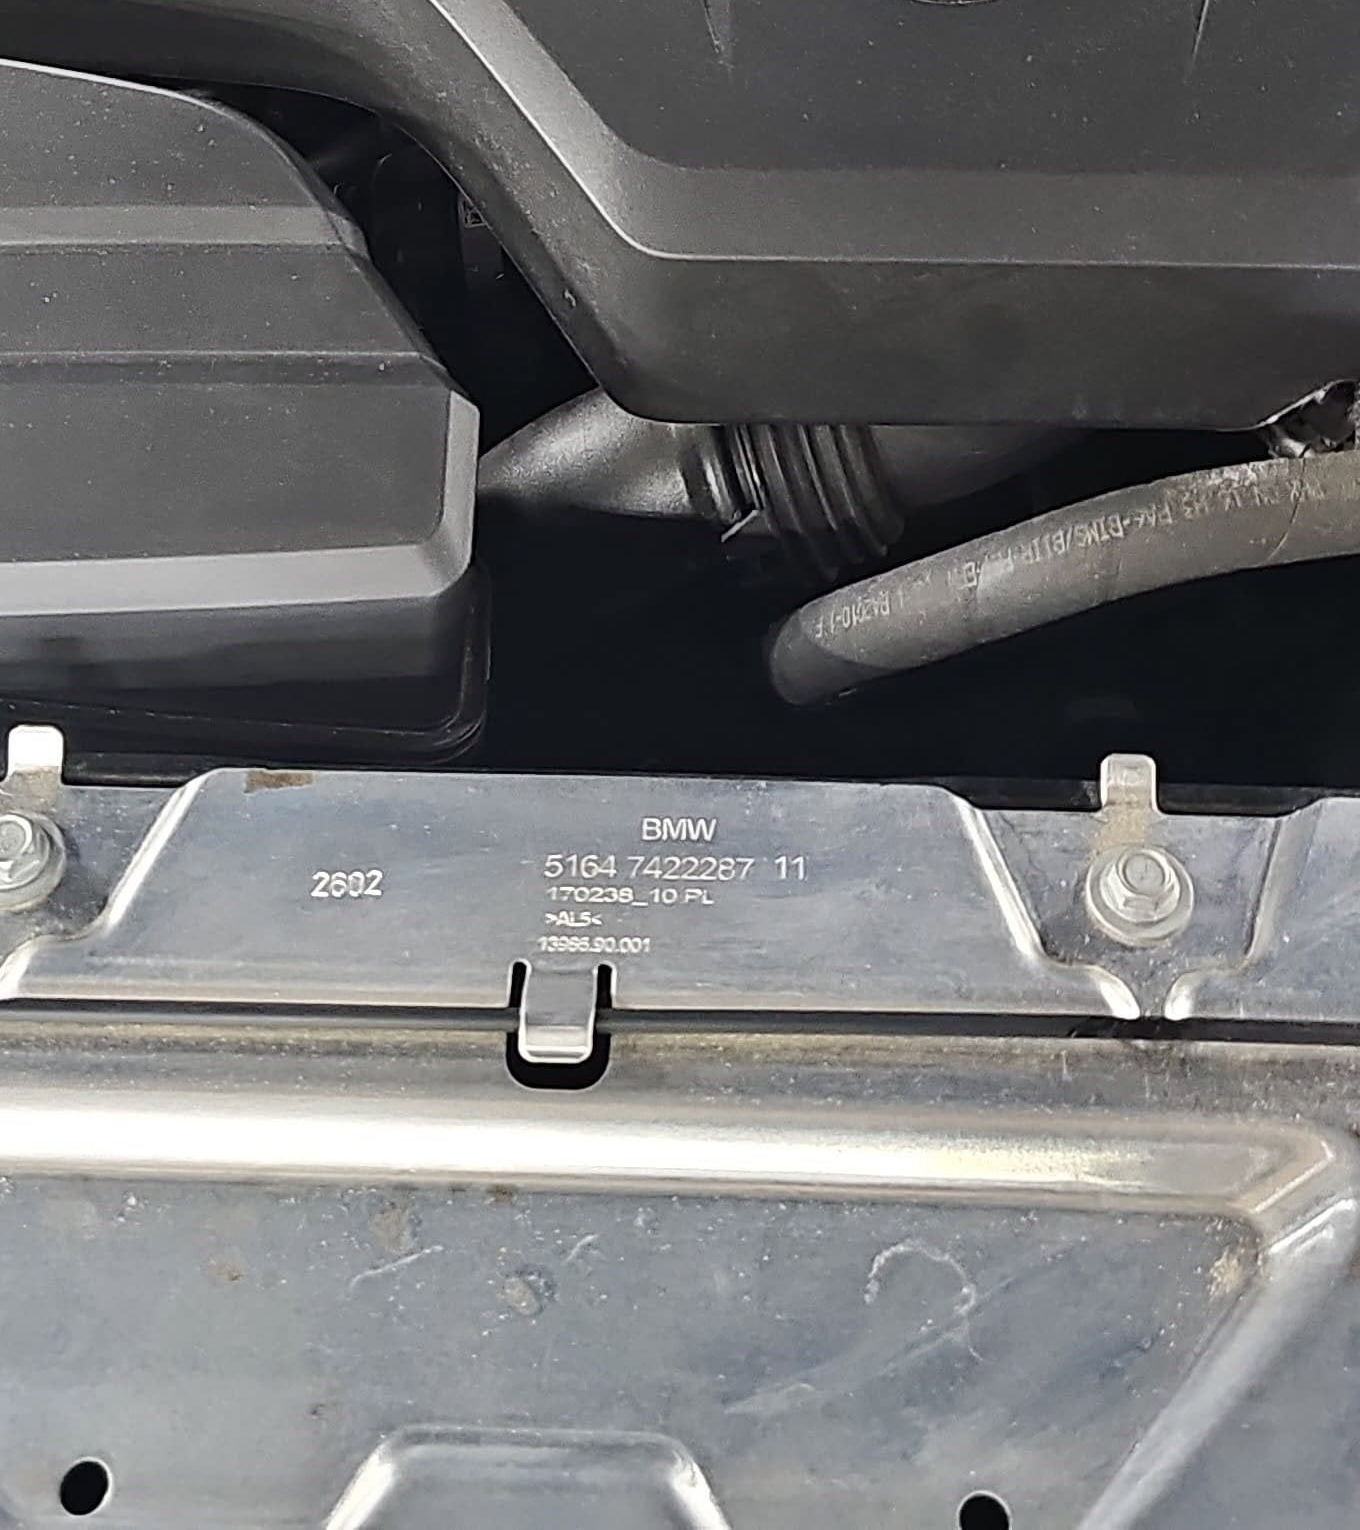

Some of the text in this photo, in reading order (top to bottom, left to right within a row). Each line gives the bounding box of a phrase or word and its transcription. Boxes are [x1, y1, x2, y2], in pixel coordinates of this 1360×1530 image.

[642, 817, 717, 842] BMW
[543, 853, 808, 881] 5164 7422287 11
